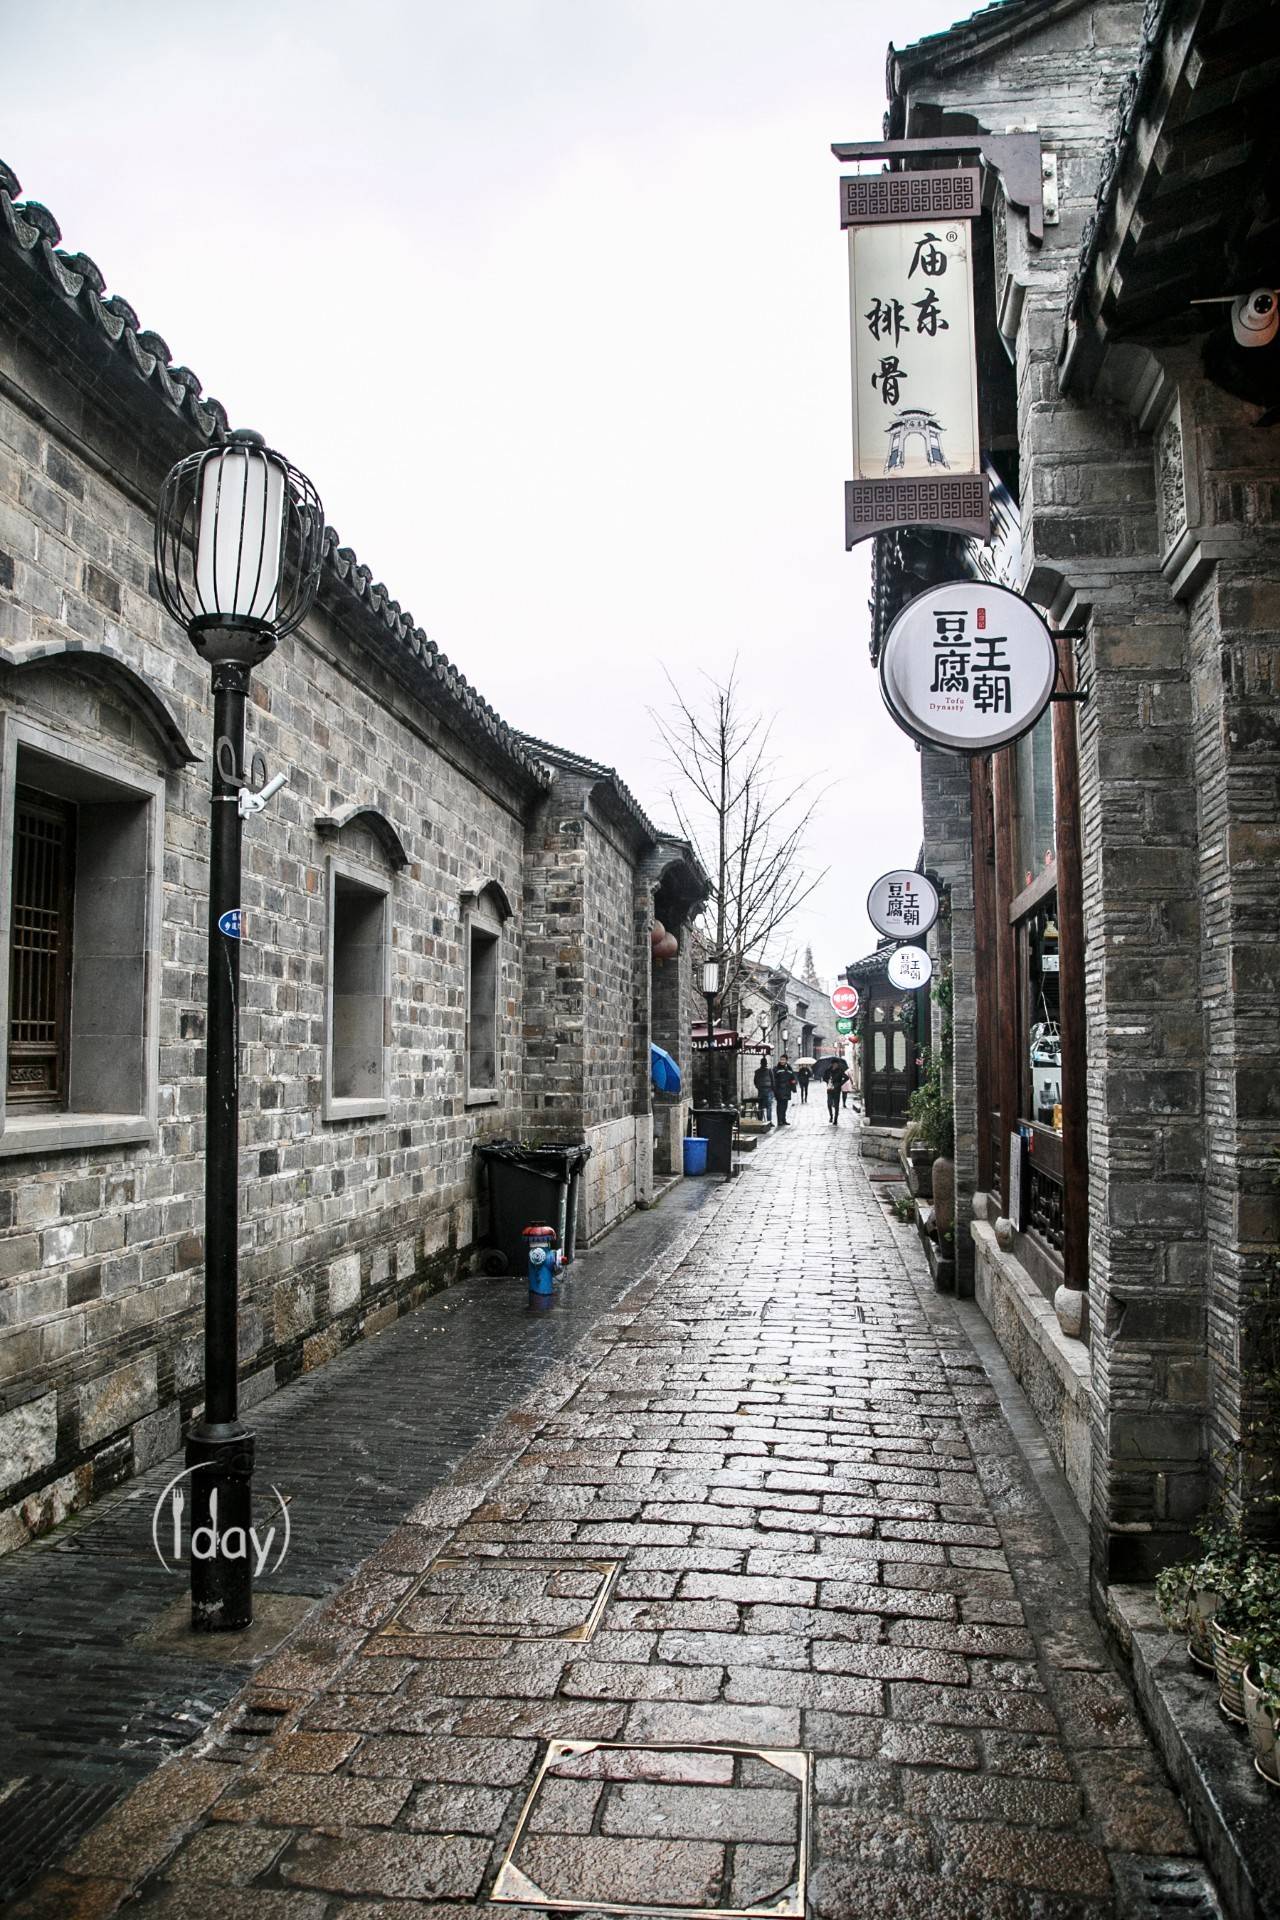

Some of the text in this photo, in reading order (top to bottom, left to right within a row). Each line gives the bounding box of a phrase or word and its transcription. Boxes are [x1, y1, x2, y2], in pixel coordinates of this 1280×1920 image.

[908, 232, 950, 337] 庙东
[863, 298, 910, 406] 排骨
[930, 610, 971, 693] 豆腐
[971, 636, 1012, 714] 王朝
[929, 703, 964, 712] Dynasty
[886, 882, 904, 916] 豆腐
[903, 893, 920, 926] 王朝
